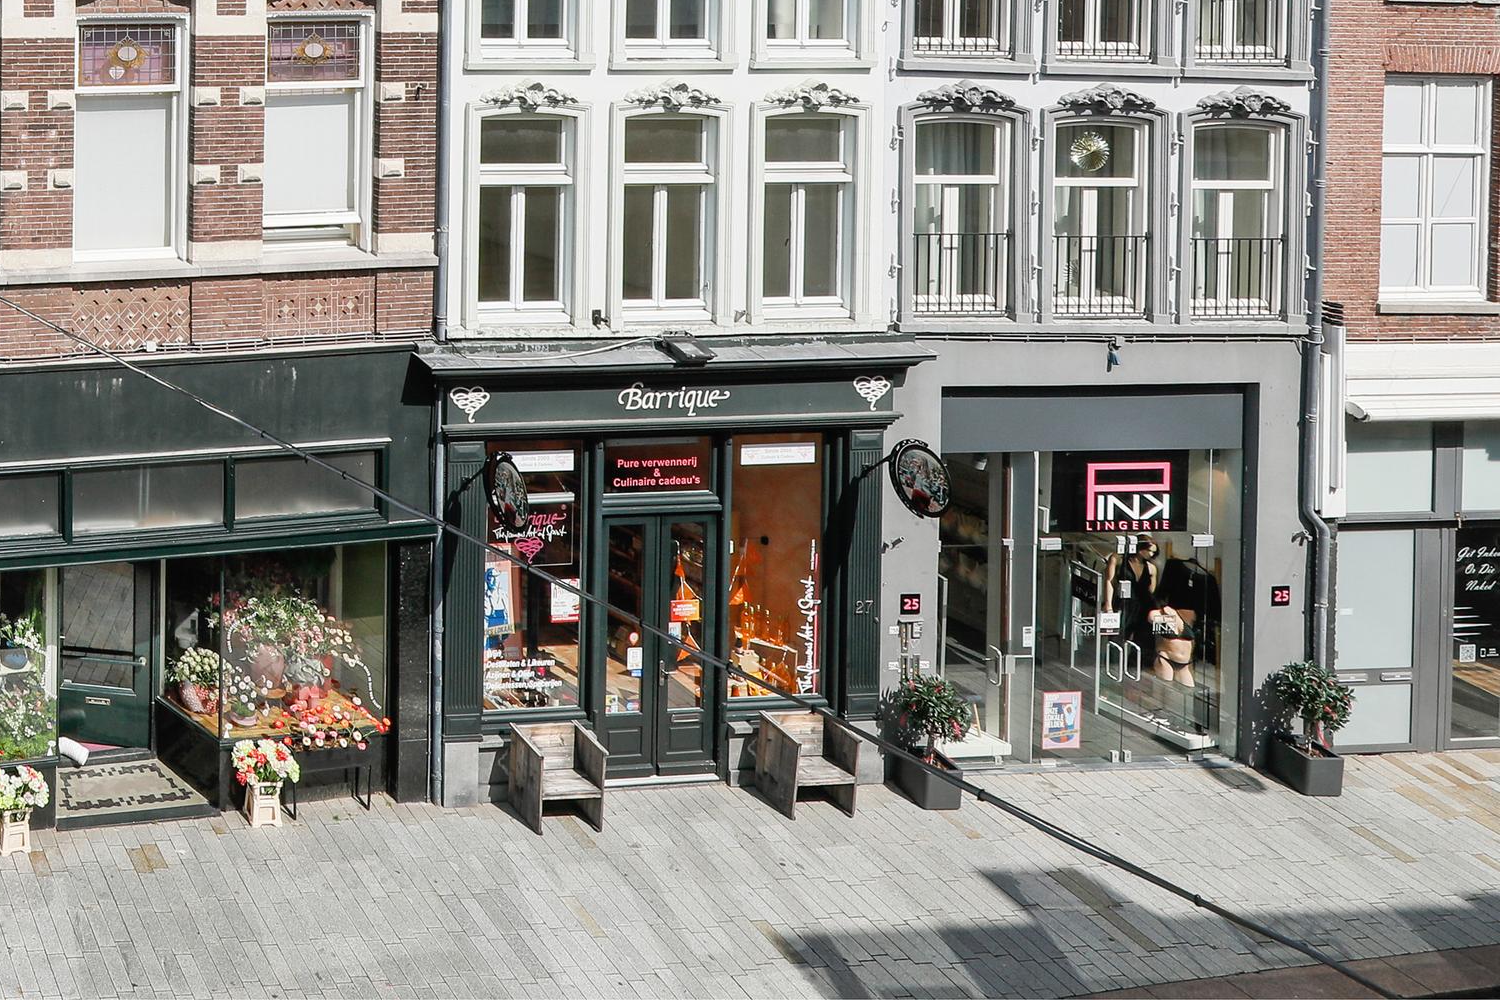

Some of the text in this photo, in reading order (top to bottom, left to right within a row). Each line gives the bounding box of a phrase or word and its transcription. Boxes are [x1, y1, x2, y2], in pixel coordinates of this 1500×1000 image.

[618, 382, 731, 416] Barrique
[617, 456, 698, 468] Pure verwennerij
[653, 468, 661, 477] &
[104, 468, 194, 490] ANNO 1898
[613, 475, 701, 487] Culinaire cadeau's
[1086, 462, 1170, 520] PINK
[1086, 520, 1170, 531] LINGERIE
[1456, 547, 1476, 562] Get
[1464, 563, 1496, 575] Or Die
[1465, 580, 1497, 591] Naked
[1274, 590, 1289, 602] 25
[855, 600, 873, 614] 27
[903, 598, 919, 610] 25
